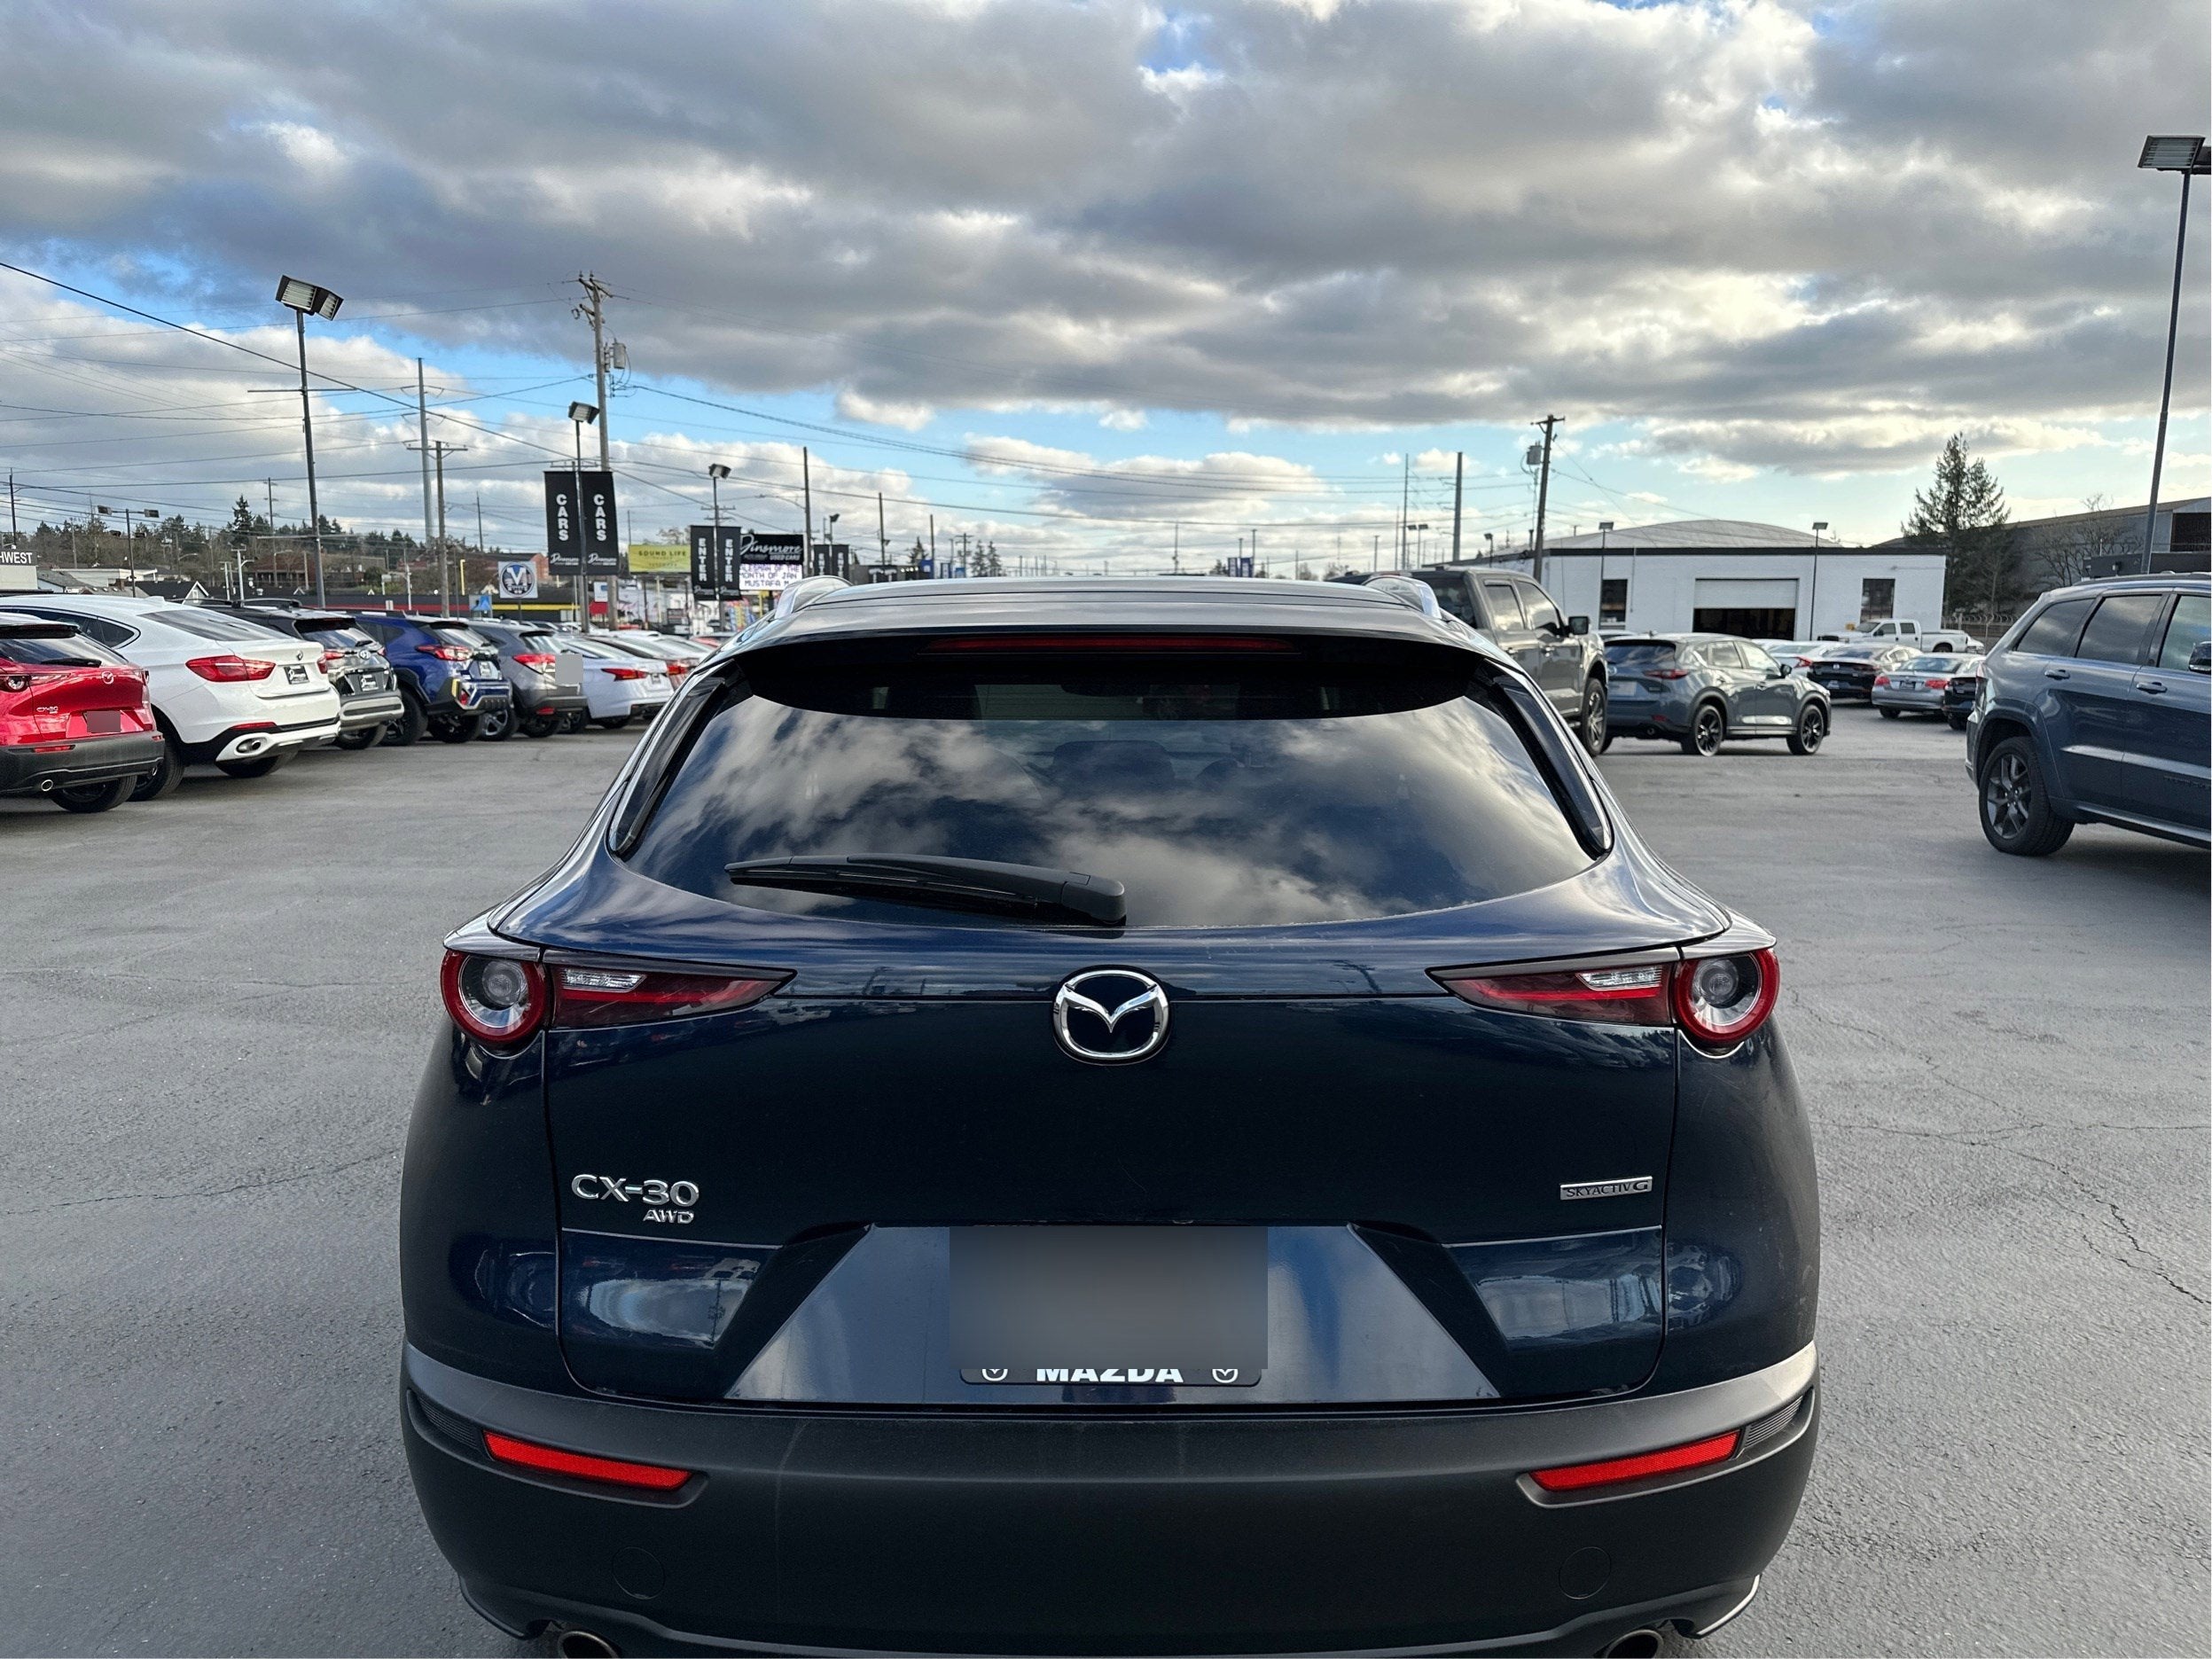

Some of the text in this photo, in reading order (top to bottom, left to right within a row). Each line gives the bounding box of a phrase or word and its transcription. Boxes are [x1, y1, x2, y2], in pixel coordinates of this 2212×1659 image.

[556, 493, 569, 541] CARS
[593, 493, 607, 541] CARS
[698, 537, 707, 582] ENTER
[724, 538, 734, 583] ENTER
[571, 1174, 700, 1207] CX-30
[642, 1209, 695, 1225] AWD
